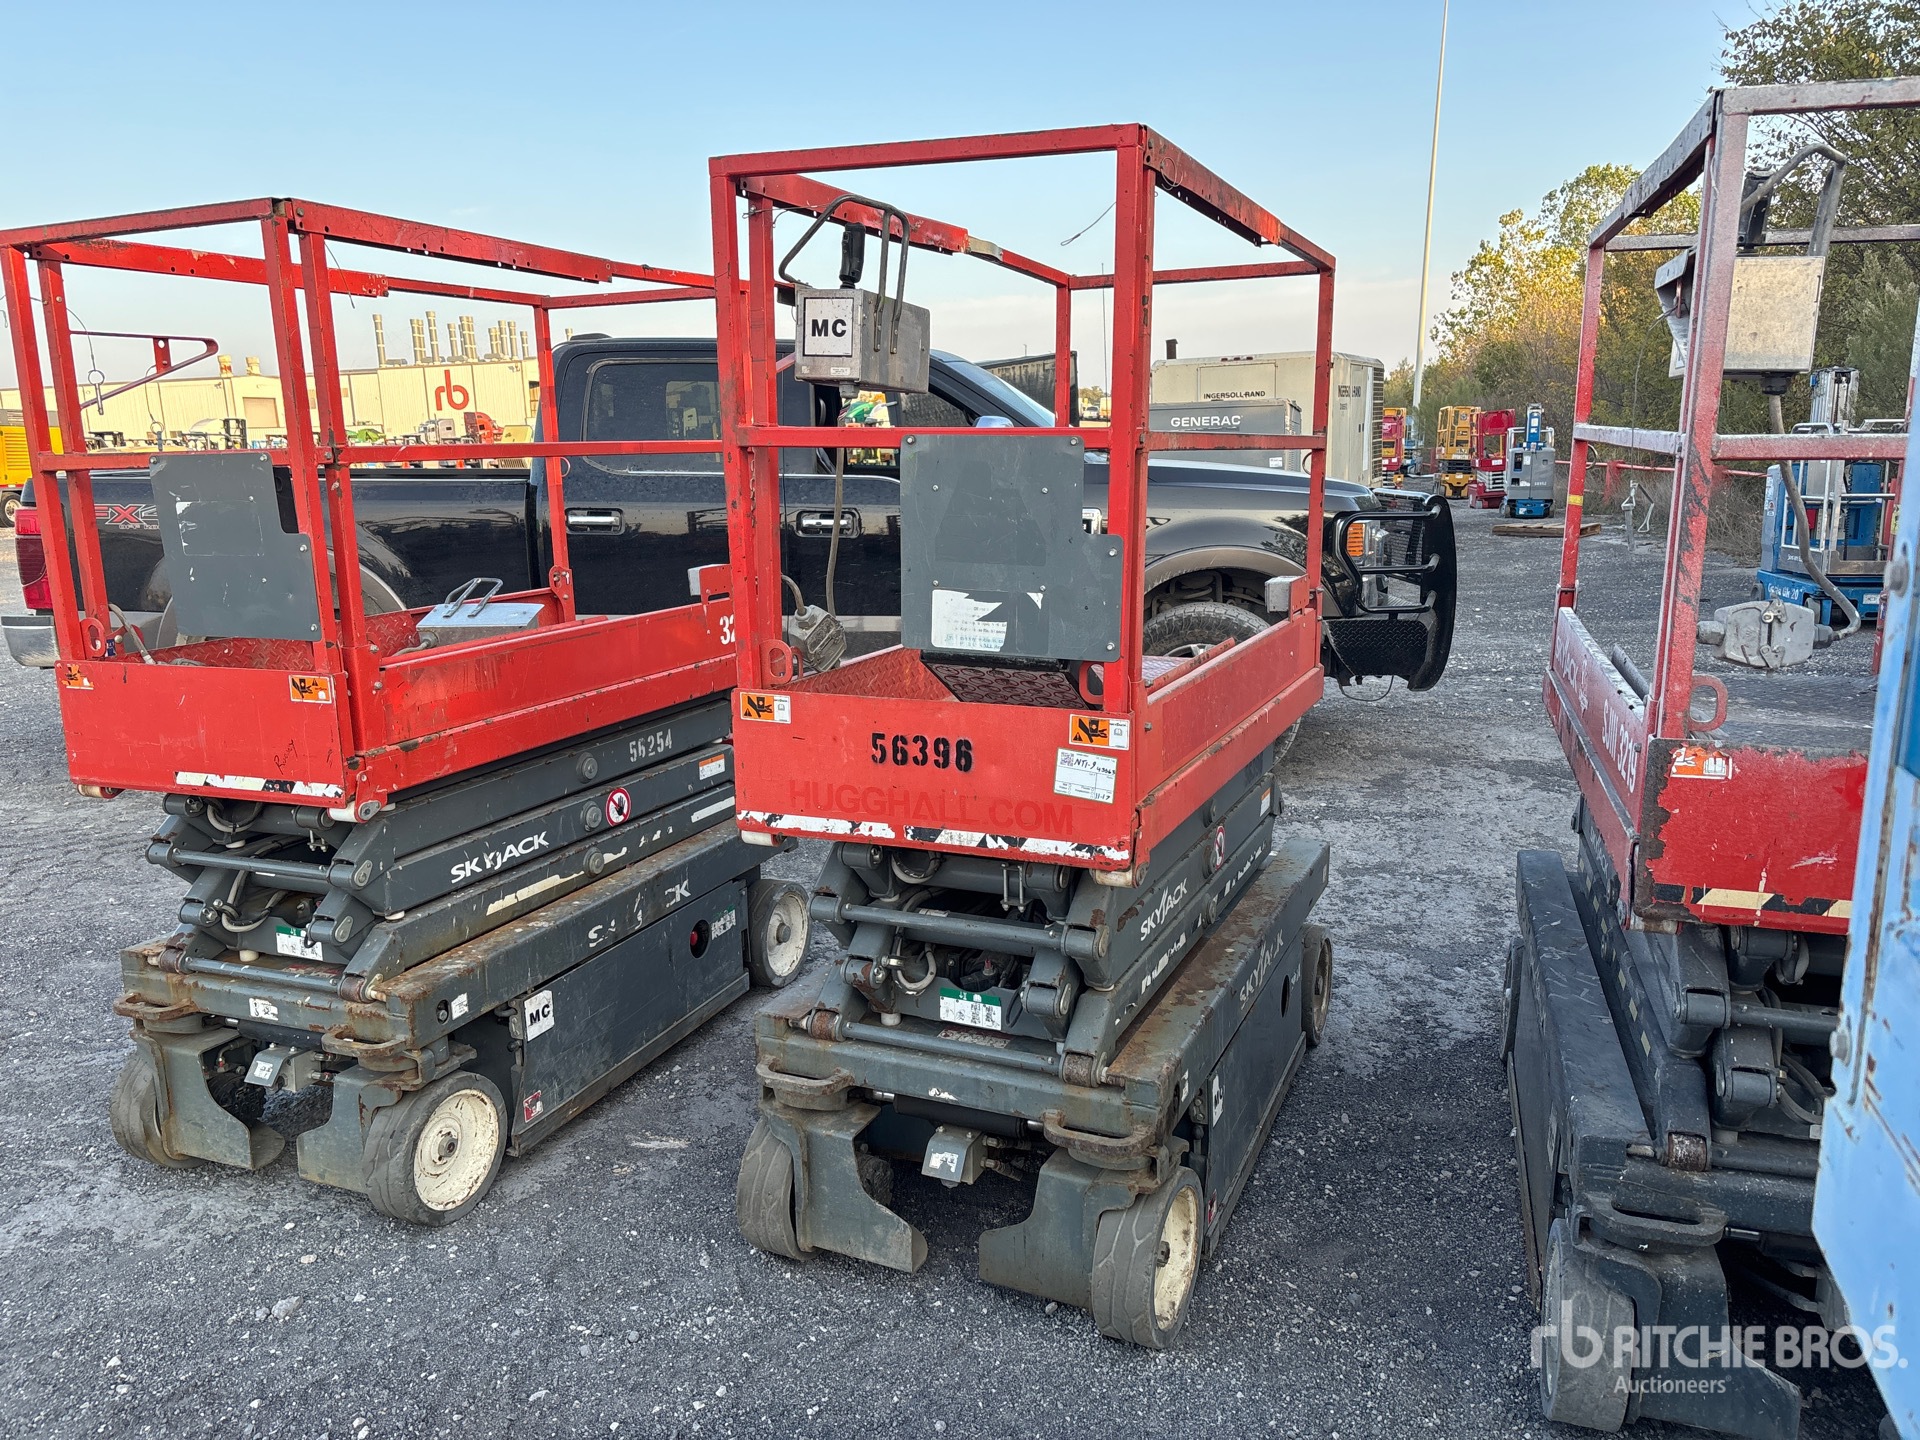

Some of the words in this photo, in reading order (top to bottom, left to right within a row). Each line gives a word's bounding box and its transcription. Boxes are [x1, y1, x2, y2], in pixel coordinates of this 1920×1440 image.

[811, 318, 847, 338] MC
[434, 369, 470, 411] rb
[1203, 390, 1266, 400] INGERSOLL-RAND
[1170, 415, 1241, 427] GENERAC
[629, 728, 673, 763] 56254
[871, 732, 974, 773] 56396
[787, 779, 1074, 836] HUGGHALL.COM
[450, 830, 550, 884] SKYJACK
[1140, 877, 1188, 942] SKYJACK
[529, 1003, 551, 1026] MC
